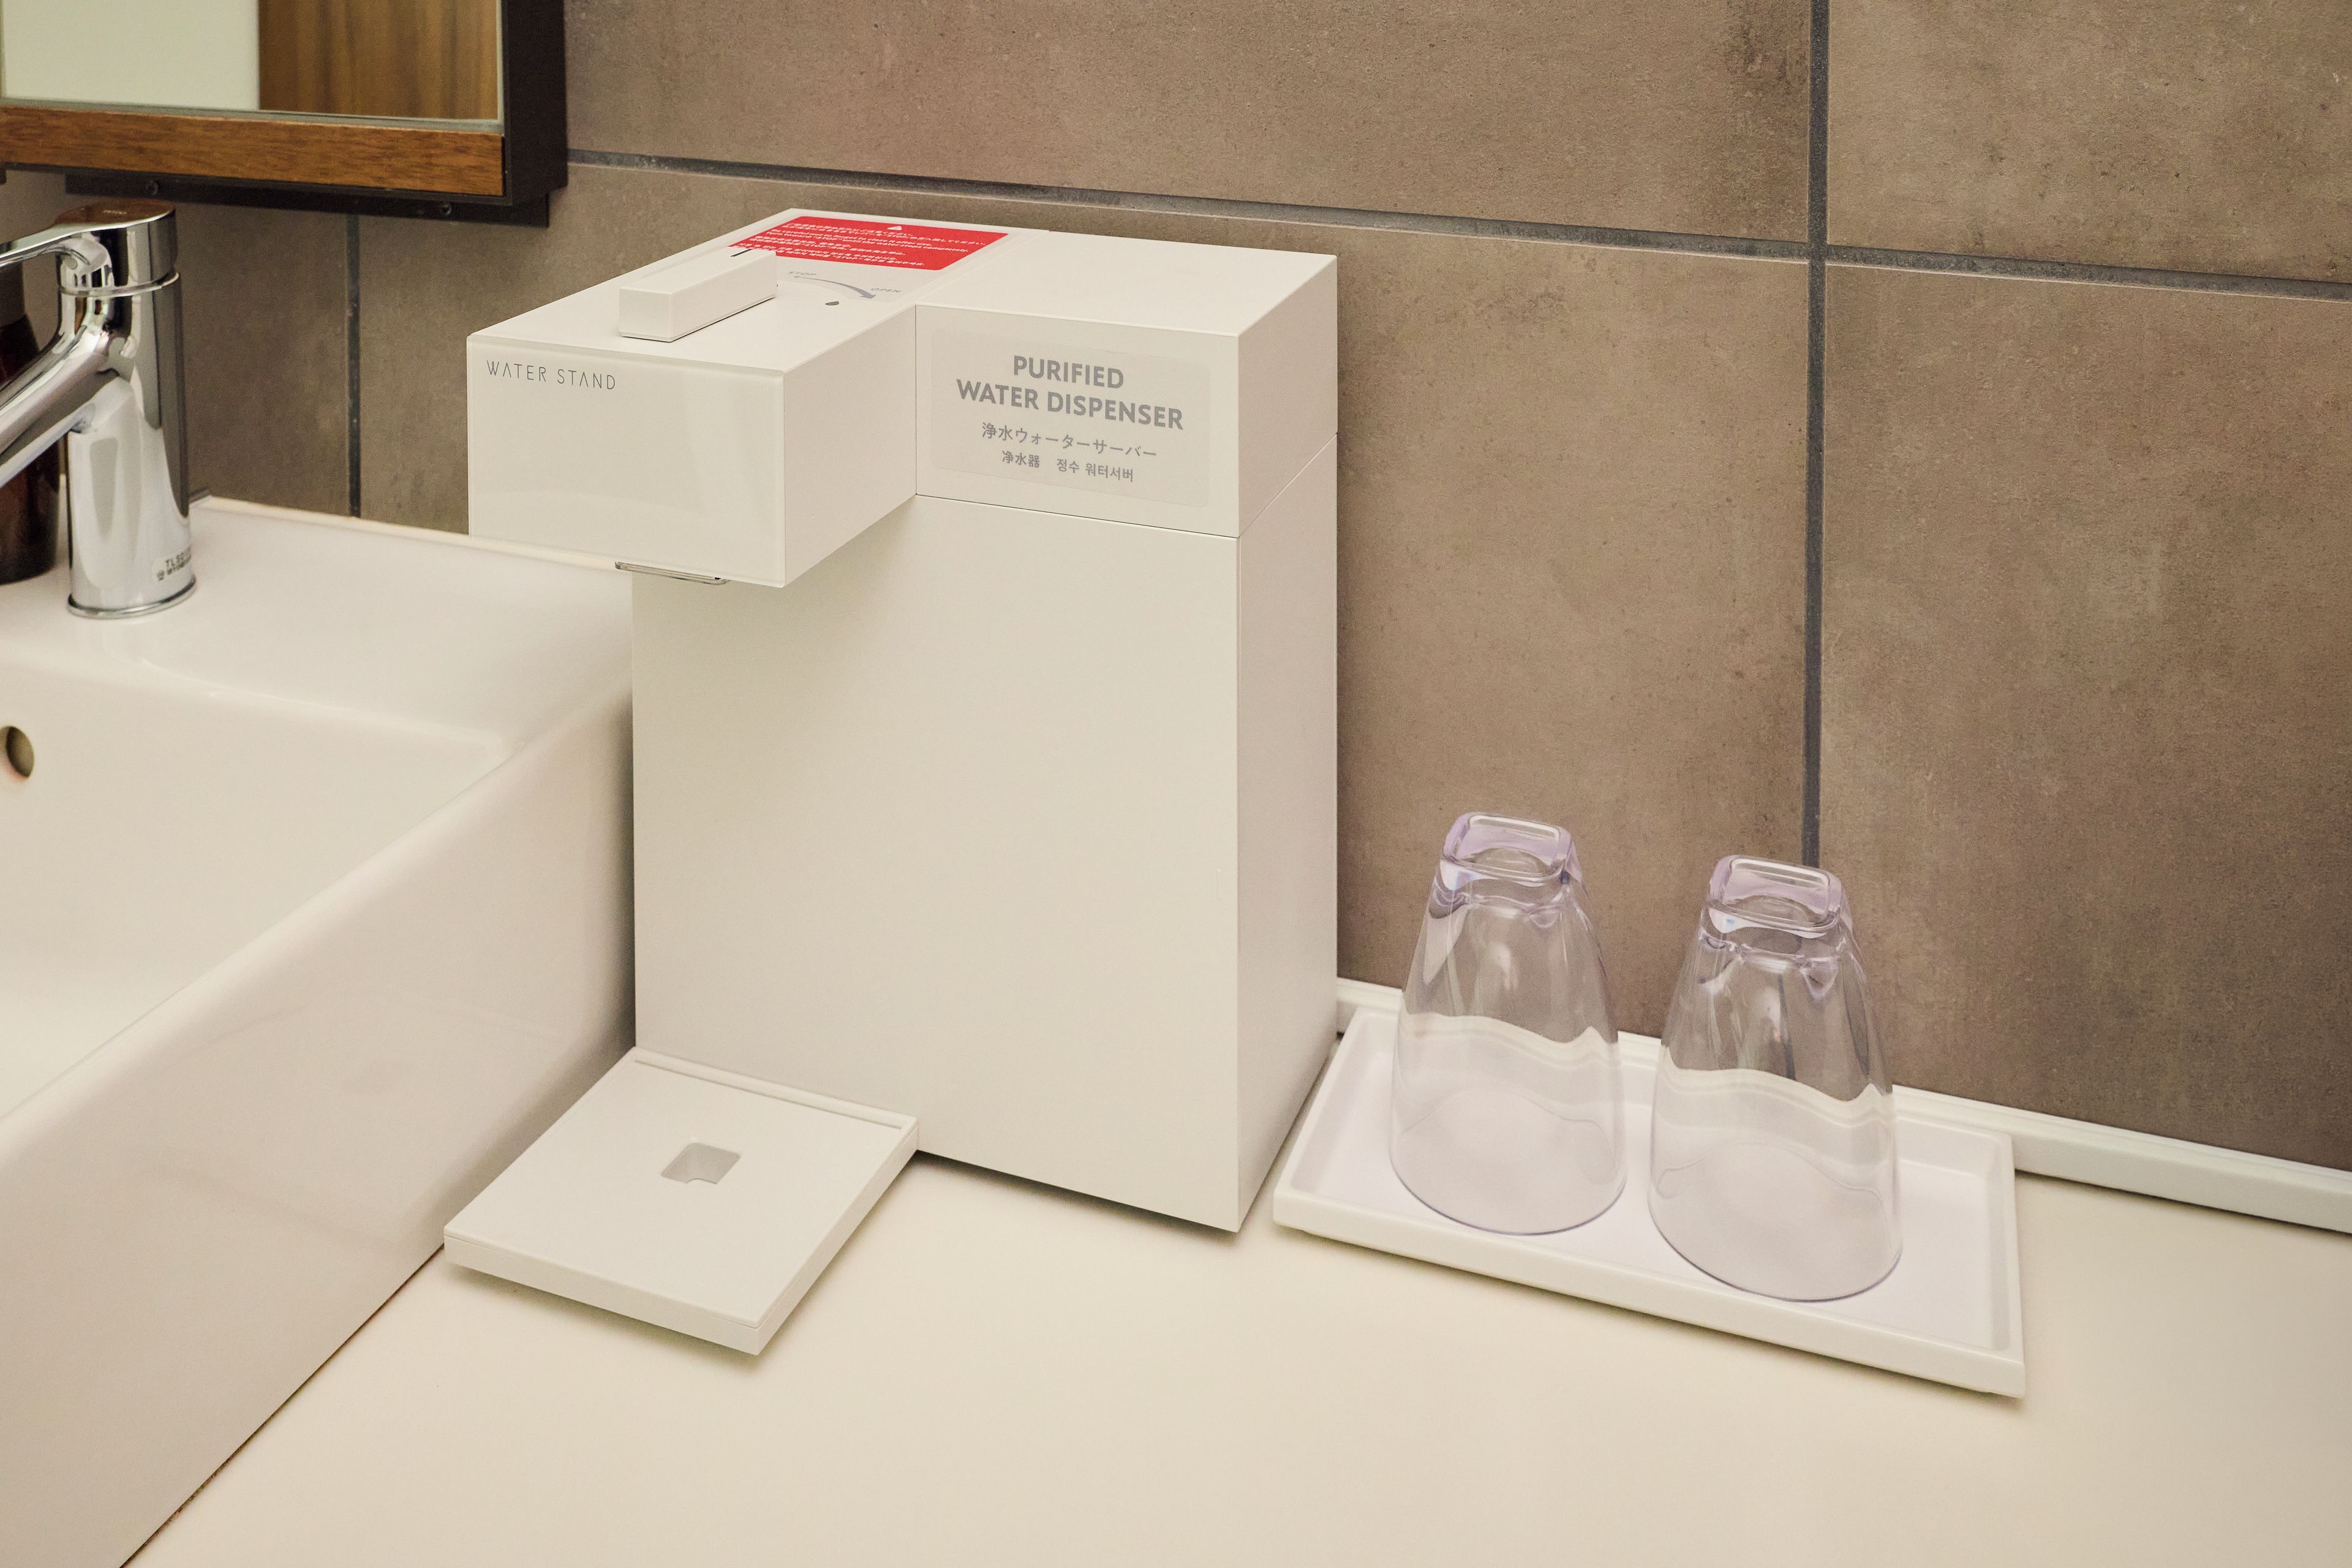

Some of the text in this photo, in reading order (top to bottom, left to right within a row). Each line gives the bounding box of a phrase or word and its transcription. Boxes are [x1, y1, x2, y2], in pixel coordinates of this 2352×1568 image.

[487, 360, 616, 390] WATER STAND
[1014, 355, 1124, 389] PURIFIED
[956, 379, 1183, 430] WATER DISPENSER
[982, 422, 1156, 456] 浄水ウォーターサーバー
[1002, 450, 1040, 469] 净水器
[1057, 459, 1134, 482] 정수 워터서버
